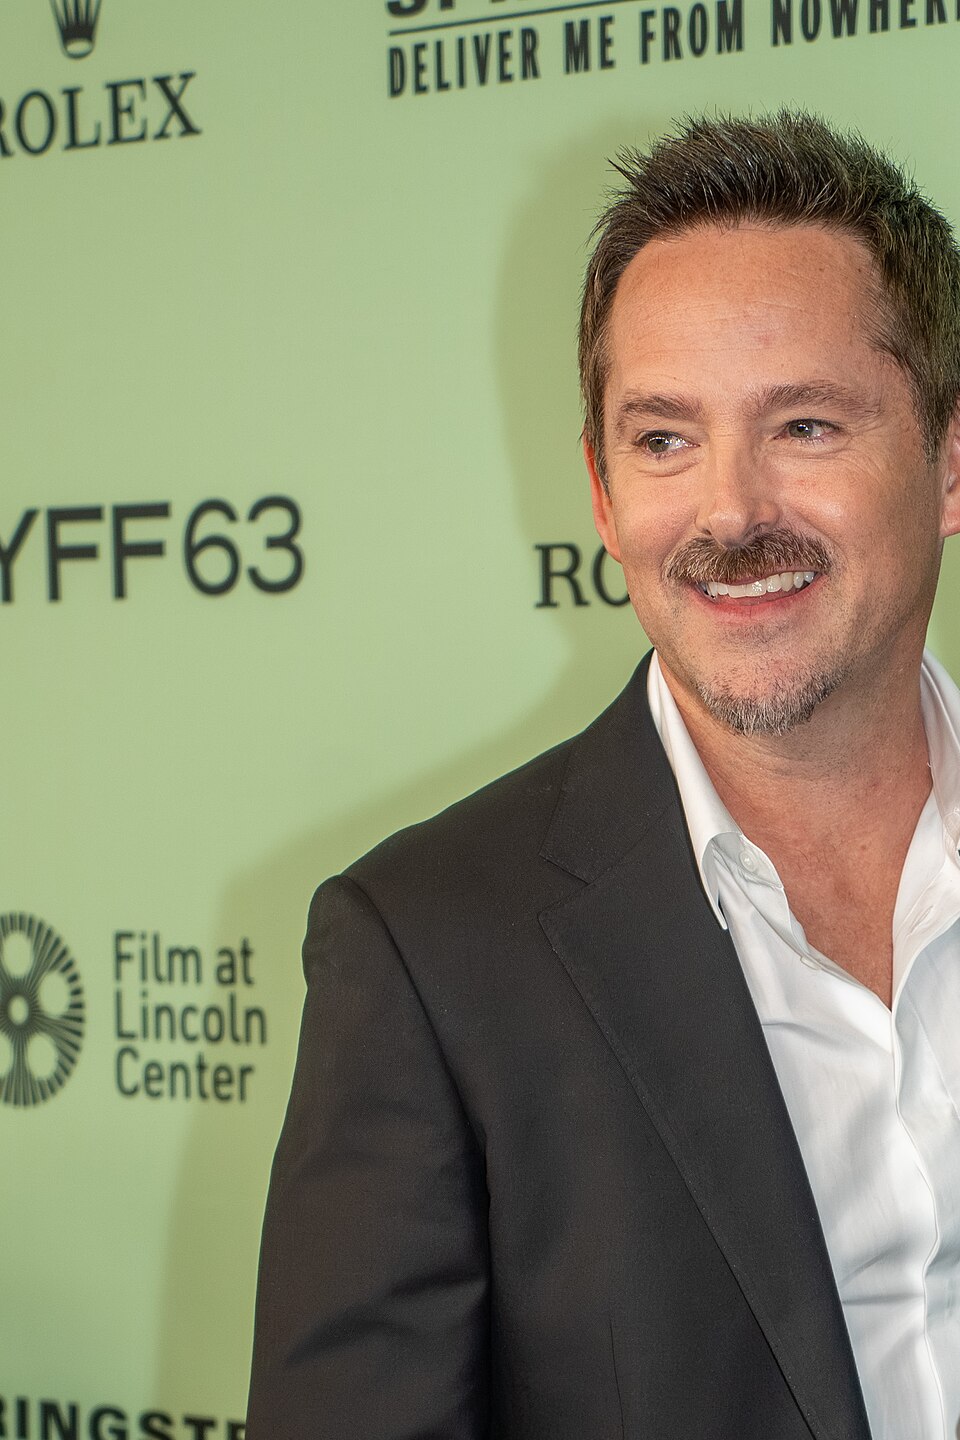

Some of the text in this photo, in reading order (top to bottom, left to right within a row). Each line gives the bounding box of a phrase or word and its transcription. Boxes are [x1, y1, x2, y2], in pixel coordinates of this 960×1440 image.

[388, 27, 541, 98] DELIVER
[564, 15, 616, 75] ME
[640, 1, 744, 64] FROM
[113, 930, 255, 986] Film at
[115, 990, 268, 1046] Lincoln
[115, 1046, 255, 1102] Center
